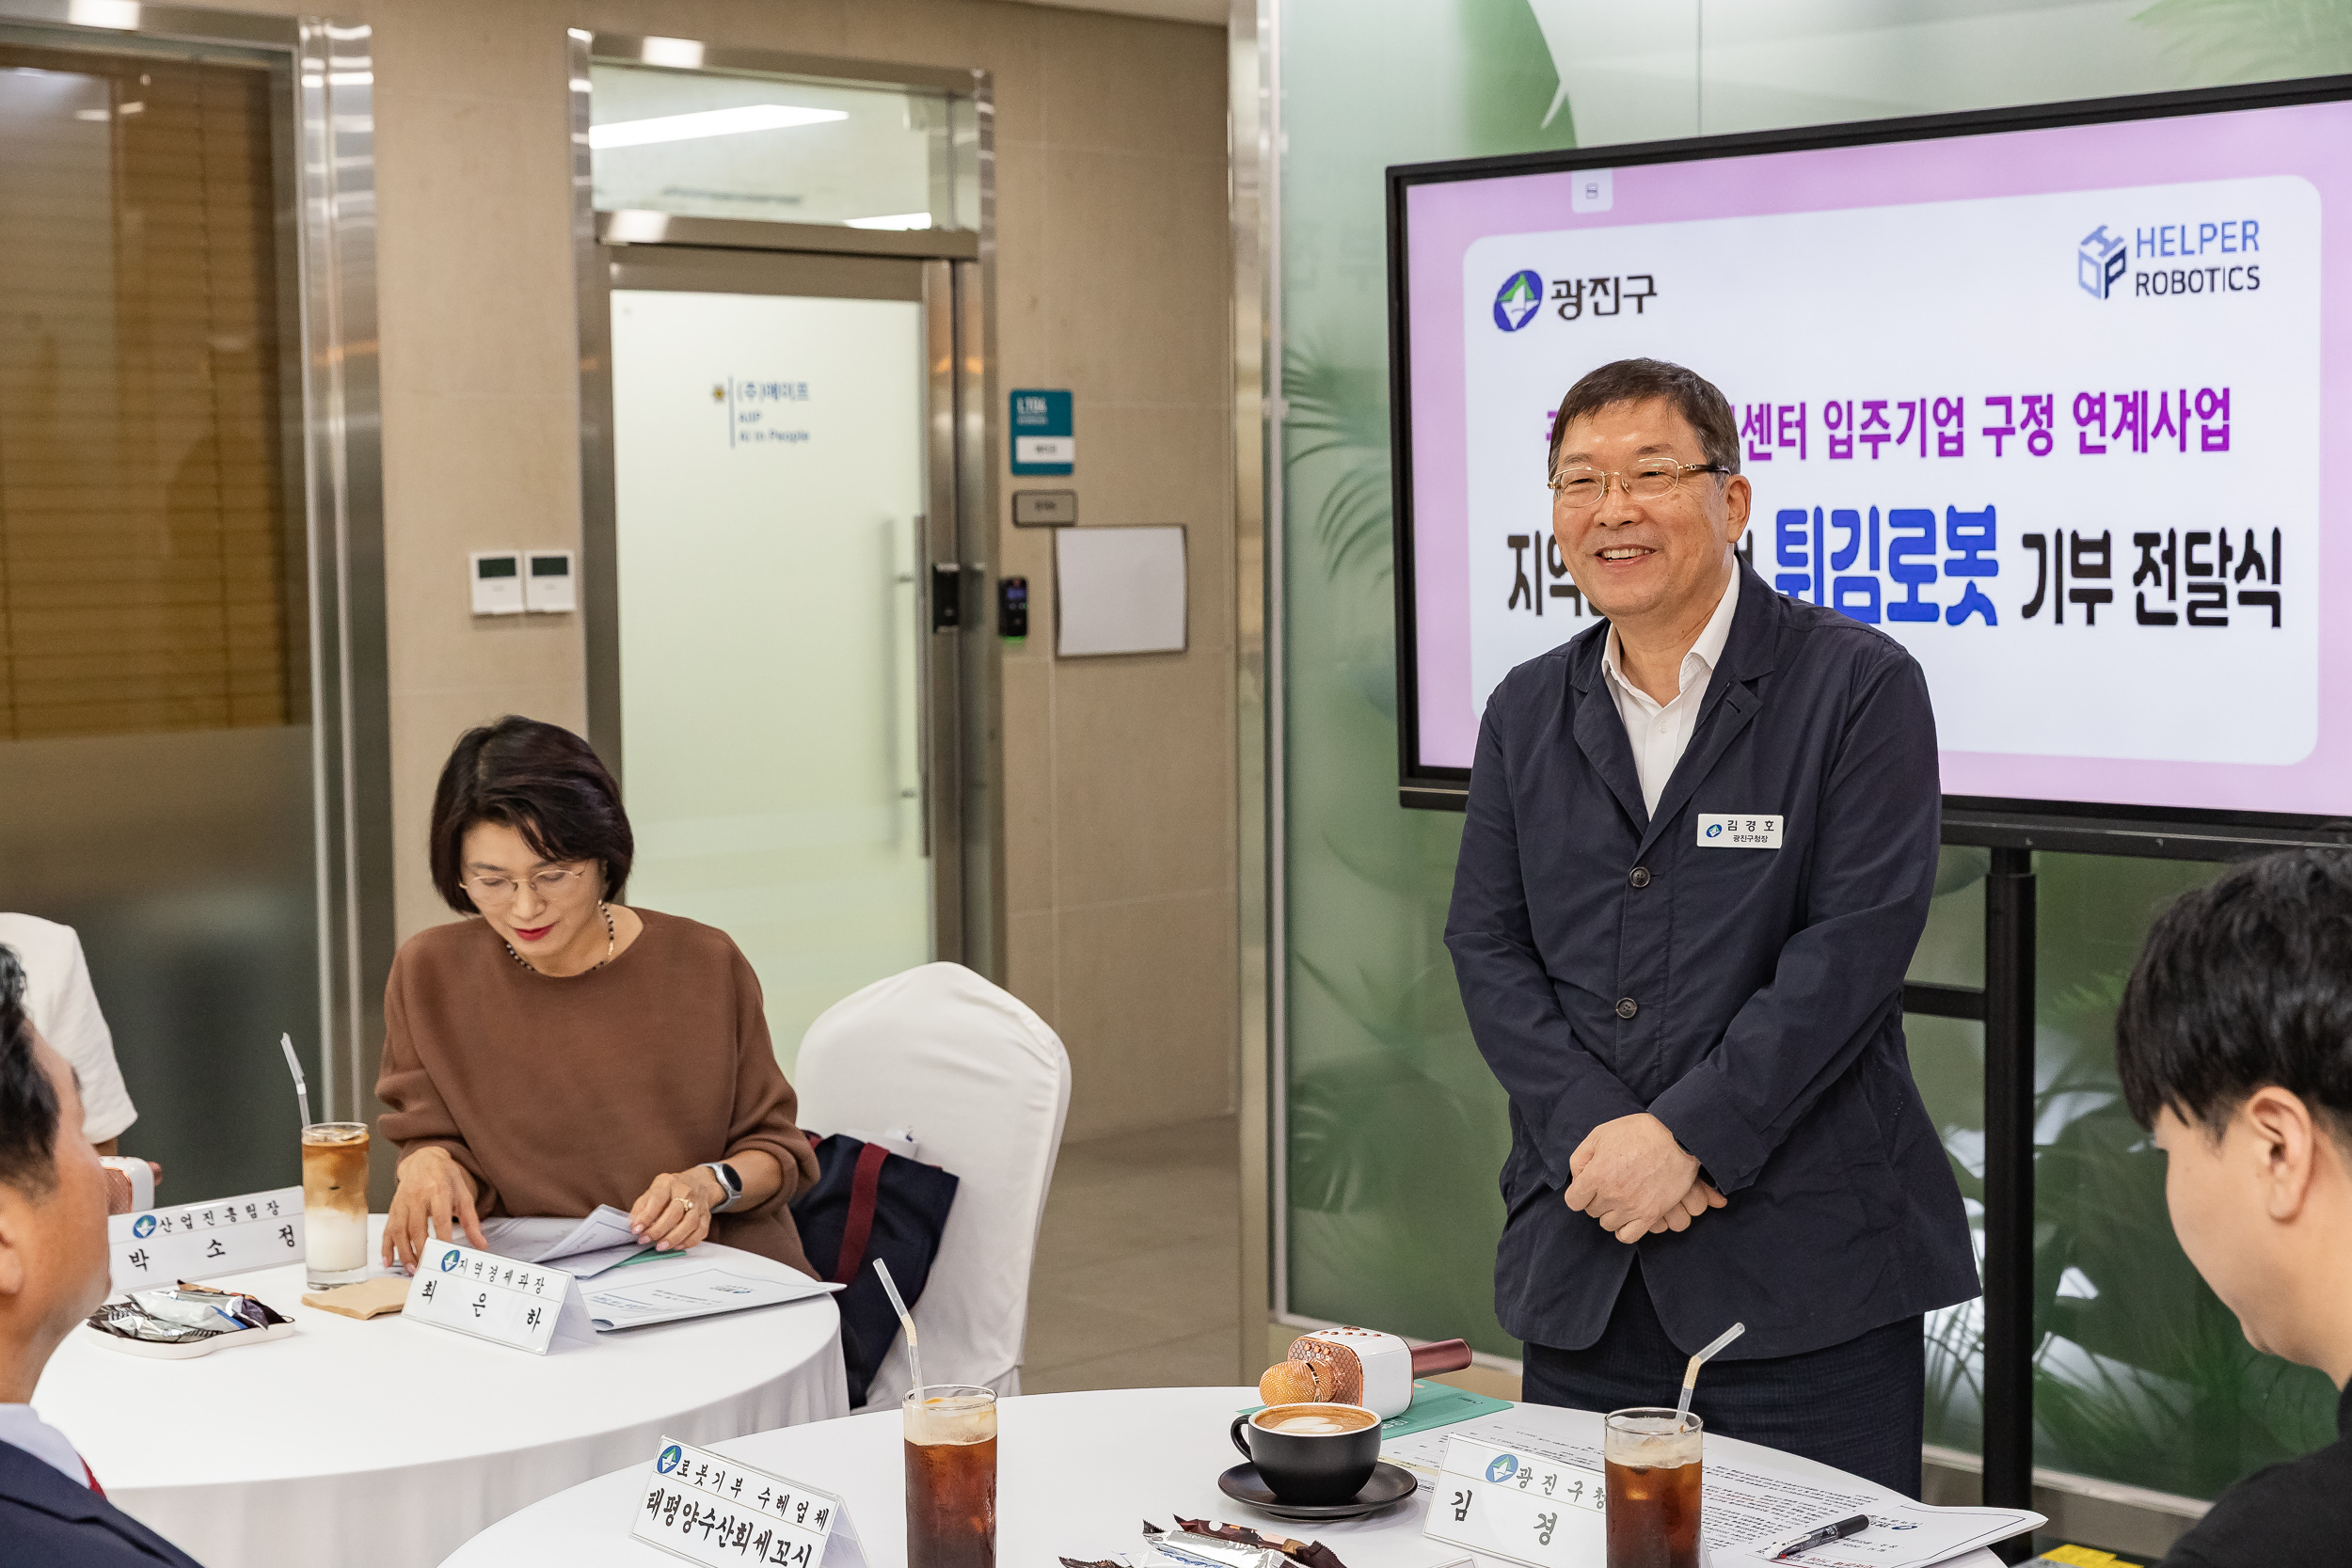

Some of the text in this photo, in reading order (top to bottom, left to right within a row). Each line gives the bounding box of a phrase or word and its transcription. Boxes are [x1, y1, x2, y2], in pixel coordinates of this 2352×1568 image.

[2136, 219, 2260, 259] HELPER
[1550, 274, 1658, 321] 광진구
[2136, 264, 2261, 297] ROBOTICS
[1731, 387, 2231, 461] 센터 입주기업 구정 연계사업
[1775, 504, 1999, 626] 튀김로봇
[2021, 528, 2114, 626] 기부
[2132, 526, 2281, 628] 전달식
[1733, 834, 1769, 843] 광진구청장
